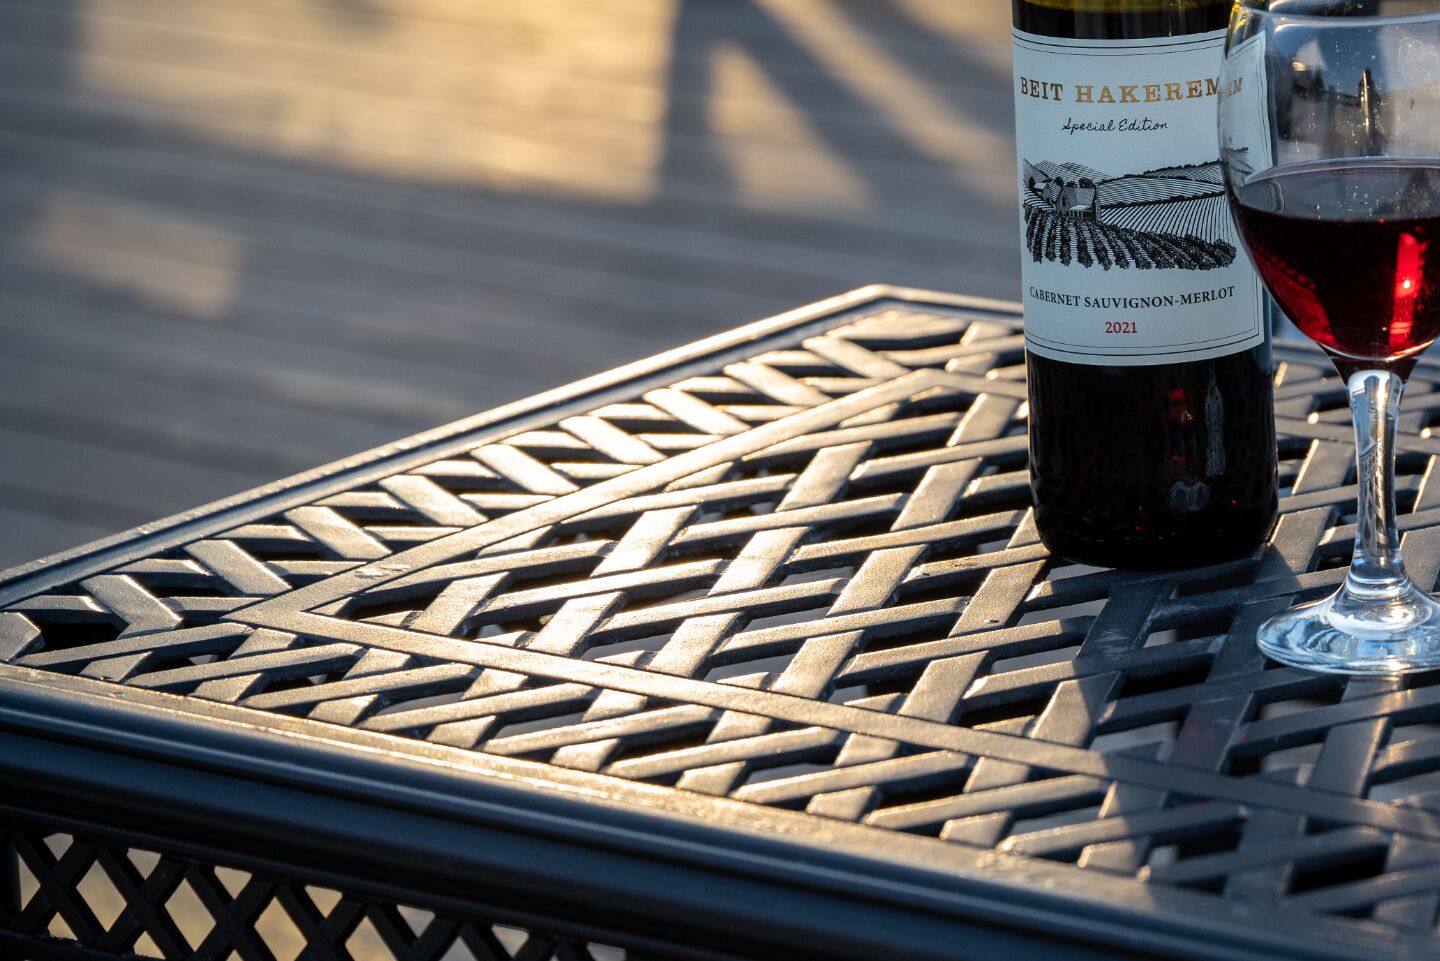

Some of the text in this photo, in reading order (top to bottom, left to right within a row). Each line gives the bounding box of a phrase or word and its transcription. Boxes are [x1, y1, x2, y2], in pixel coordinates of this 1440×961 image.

[1020, 76, 1063, 102] BEIT
[1075, 76, 1220, 104] HAKEREM
[1061, 116, 1168, 135] Special Edition
[1029, 285, 1235, 309] CABERNET SAUVIGNON-MERLOT
[1105, 321, 1138, 334] 2021
